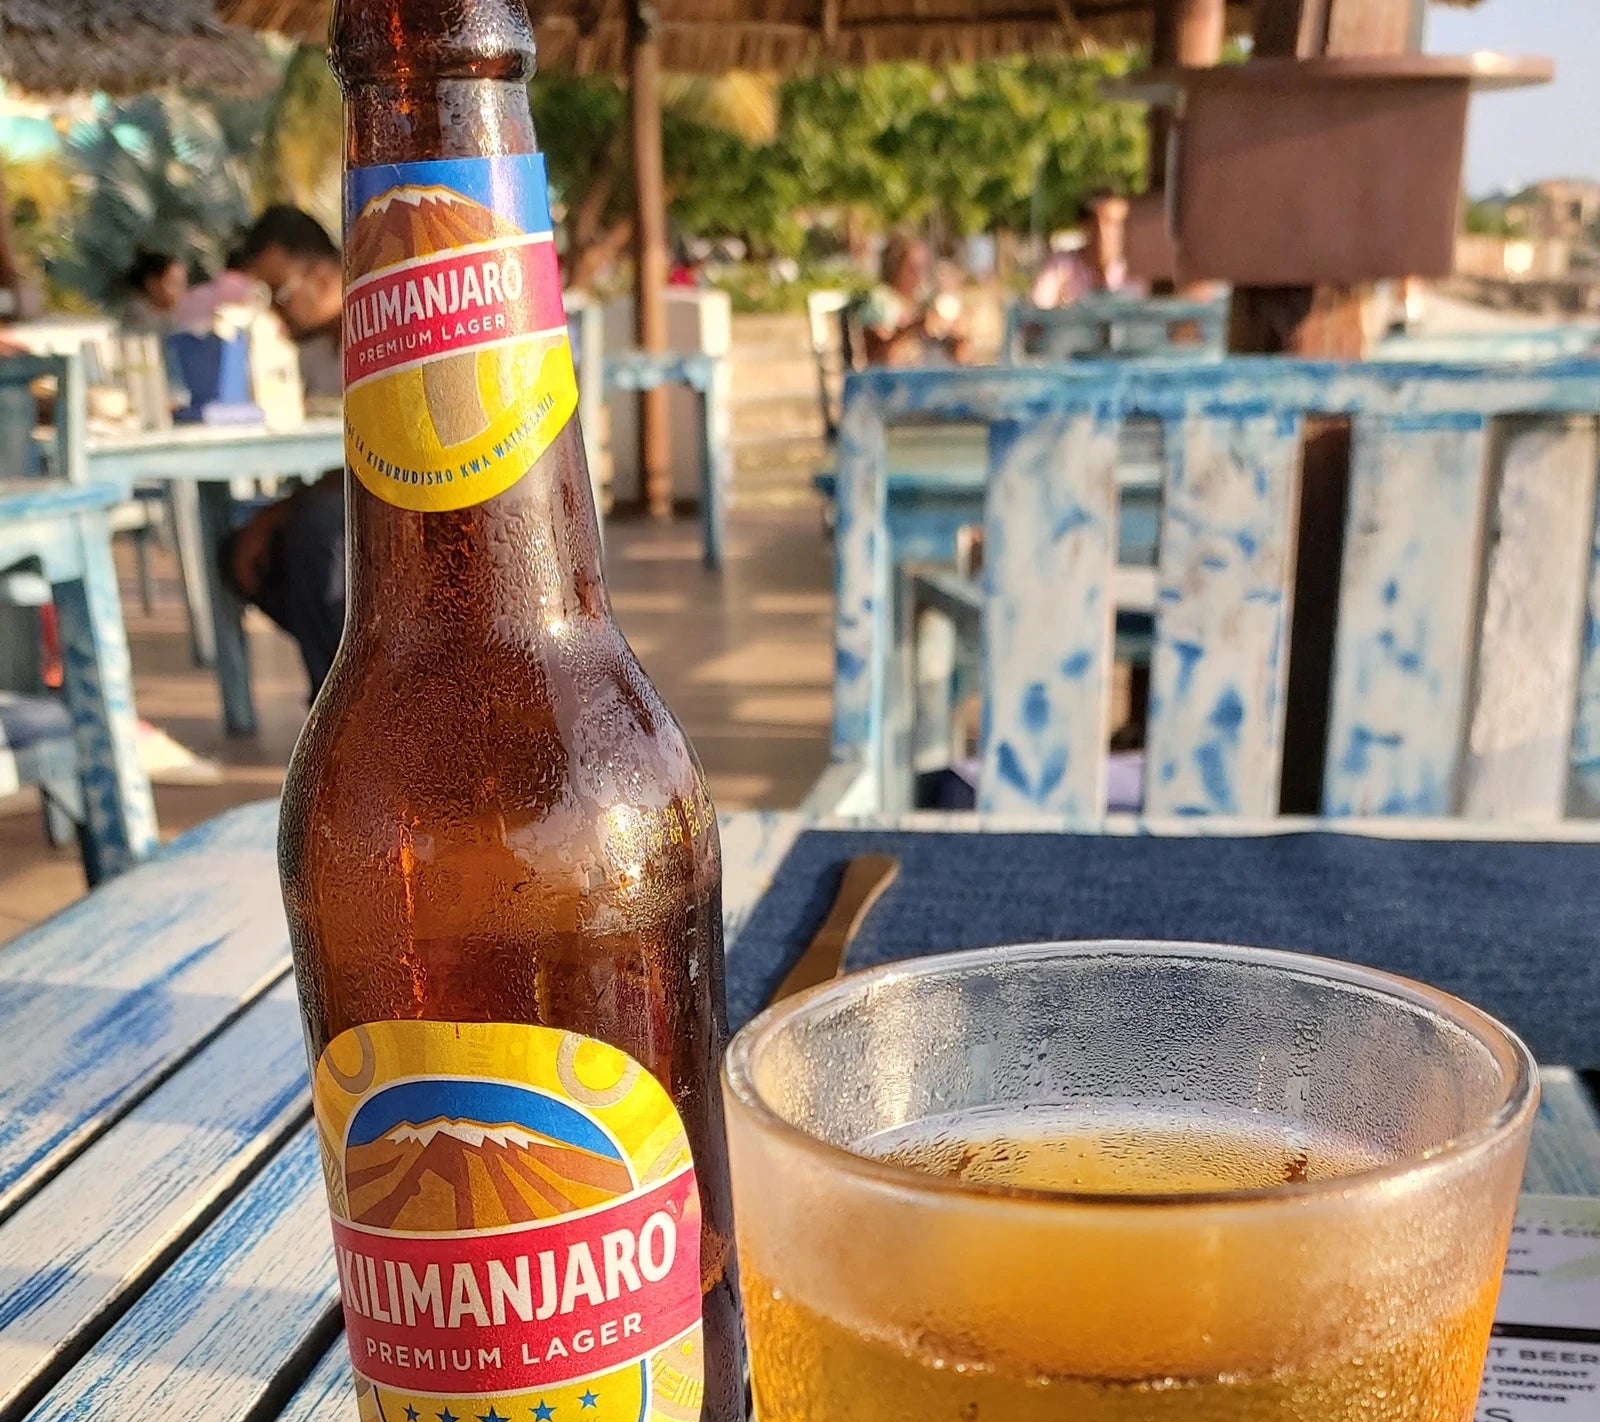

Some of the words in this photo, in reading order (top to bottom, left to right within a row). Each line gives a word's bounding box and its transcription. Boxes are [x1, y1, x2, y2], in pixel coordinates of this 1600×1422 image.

[346, 258, 524, 349] KILIMANJARO
[359, 329, 432, 366] PREMIUM
[442, 313, 507, 341] LAGER
[366, 451, 453, 485] KIBURUDISHO
[460, 455, 491, 478] KWA
[339, 1210, 677, 1329] KILIMANJARO
[366, 1338, 502, 1371] PREMIUM
[522, 1313, 643, 1366] LAGER
[1492, 1365, 1589, 1378] DRAUGHT
[1497, 1379, 1595, 1391] DRAUGHT
[1497, 1391, 1567, 1403] TOWER
